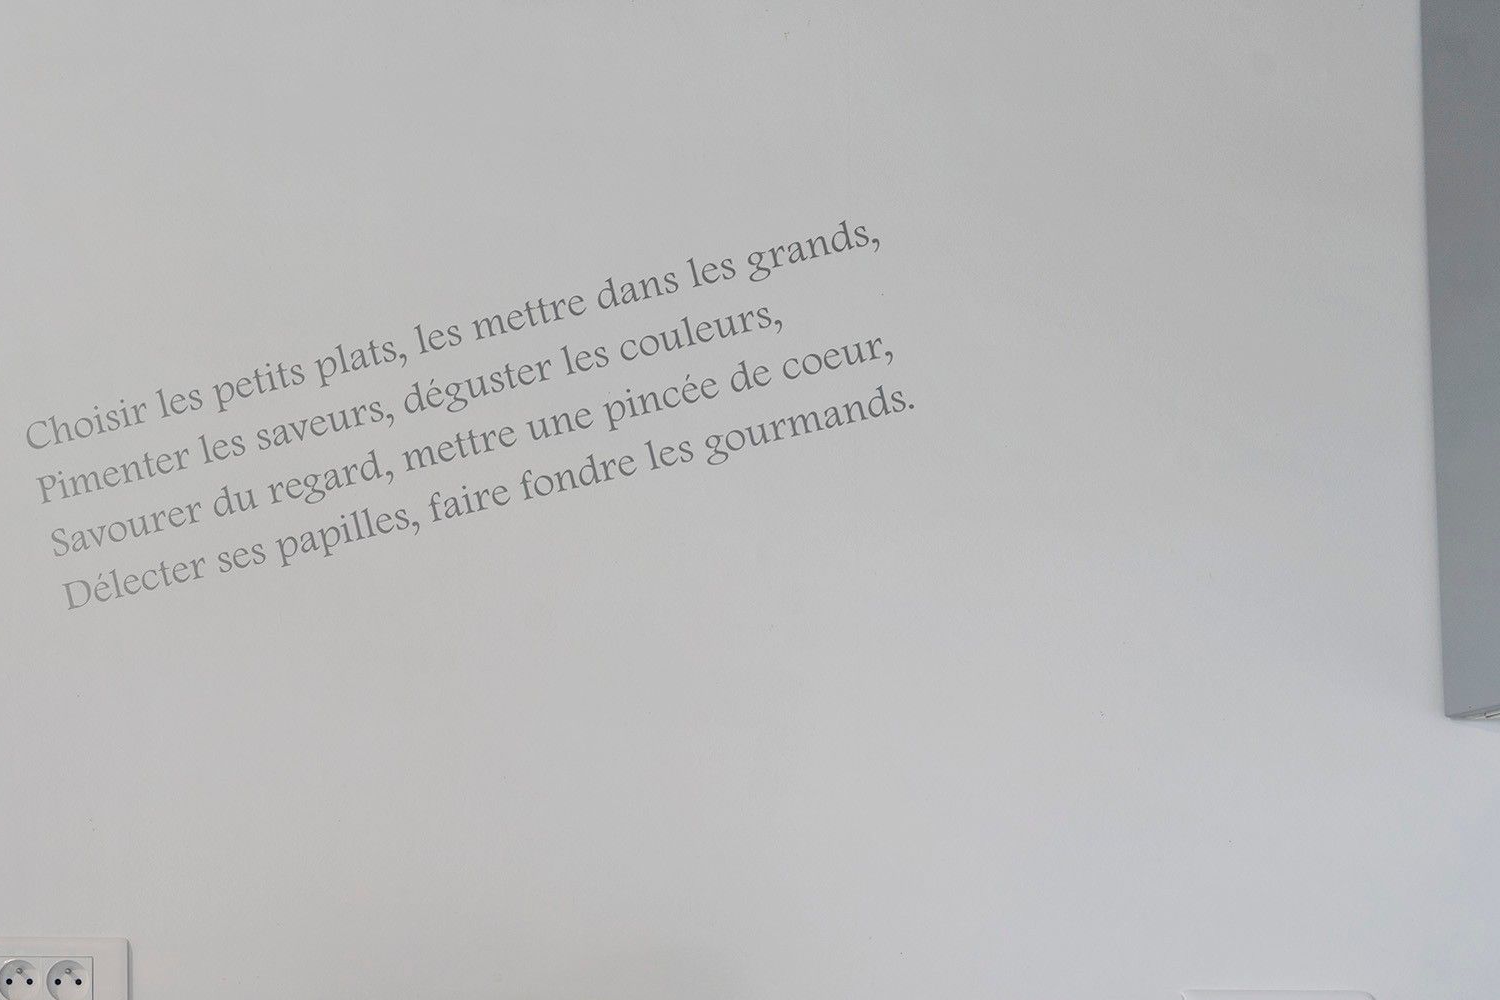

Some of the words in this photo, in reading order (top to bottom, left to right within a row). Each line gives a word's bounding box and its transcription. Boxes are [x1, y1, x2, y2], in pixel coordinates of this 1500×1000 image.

[26, 399, 147, 449] Choisir
[155, 388, 203, 418] les
[212, 362, 305, 413] petits
[314, 340, 407, 388] plats,
[414, 324, 462, 354] les
[472, 295, 587, 341] mettre
[597, 272, 679, 309] dans
[686, 257, 736, 288] les
[747, 220, 880, 282] grands,
[36, 448, 189, 504] Pimenter
[198, 434, 245, 464] les
[257, 401, 394, 450] saveurs,
[404, 359, 551, 414] déguster
[560, 345, 609, 375] les
[620, 307, 782, 361] couleurs,
[51, 502, 201, 557] Savourer
[214, 485, 259, 517] du
[267, 449, 394, 504] regard,
[402, 427, 517, 472] mettre
[526, 408, 594, 440] une
[603, 374, 720, 432] pincée
[731, 360, 772, 392] de
[783, 337, 893, 380] coeur,
[62, 557, 205, 610] Délecter
[218, 544, 266, 573] ses
[275, 508, 420, 567] papilles,
[429, 485, 511, 522] faire
[520, 454, 637, 500] fondre
[644, 440, 694, 470] les
[705, 385, 914, 465] gourmands.
